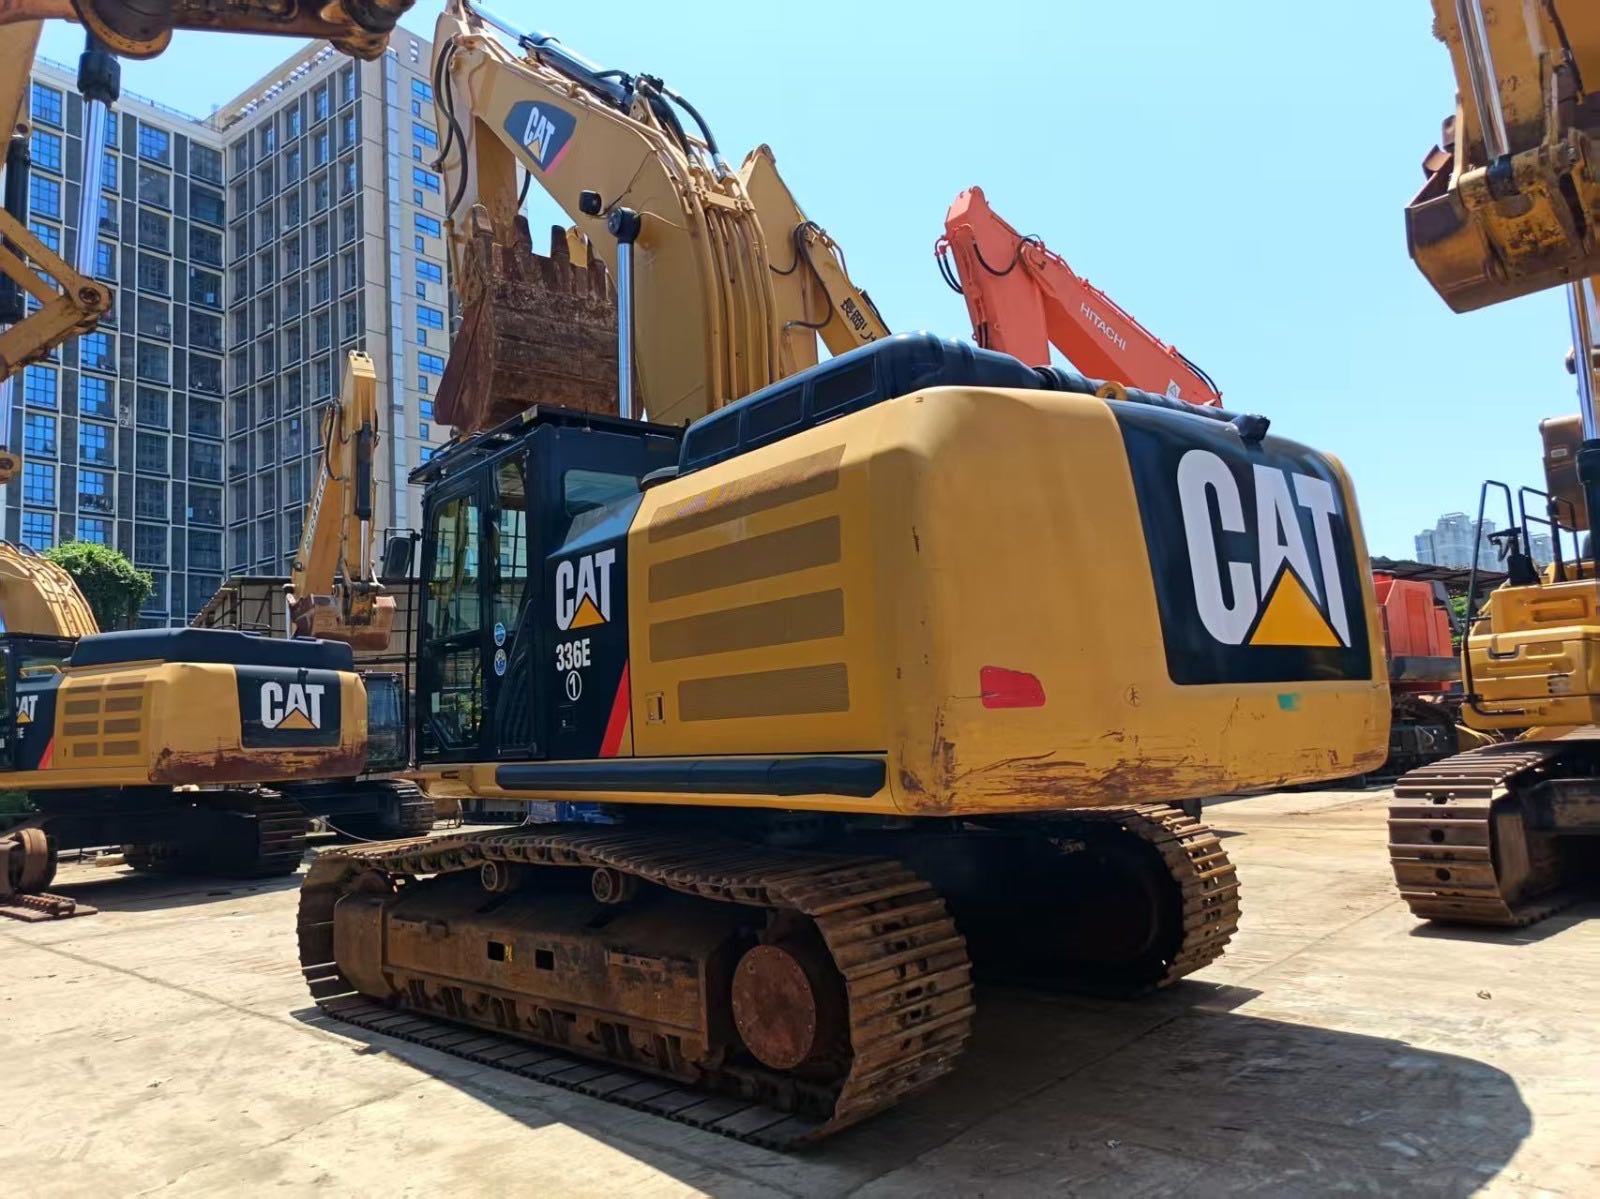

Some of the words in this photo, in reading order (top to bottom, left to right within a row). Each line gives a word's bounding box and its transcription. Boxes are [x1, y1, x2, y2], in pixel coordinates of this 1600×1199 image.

[523, 106, 556, 164] CAT
[1080, 301, 1126, 351] HITACHI
[1177, 449, 1351, 648] CAT
[556, 548, 615, 631] CAT
[555, 638, 591, 672] 336E
[15, 694, 39, 723] AT
[260, 681, 325, 729] CAT
